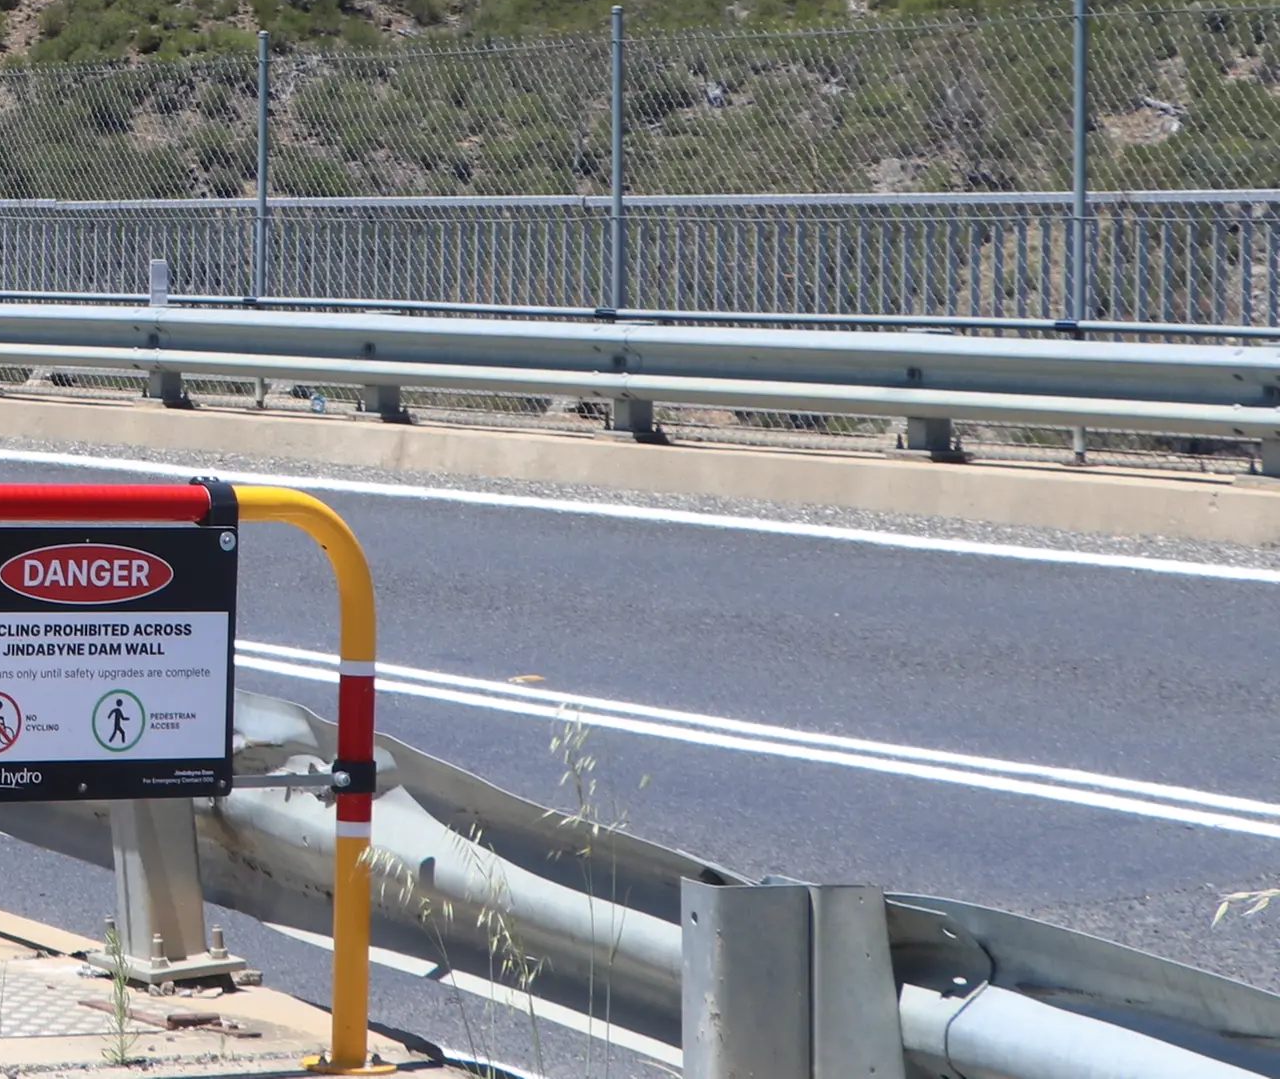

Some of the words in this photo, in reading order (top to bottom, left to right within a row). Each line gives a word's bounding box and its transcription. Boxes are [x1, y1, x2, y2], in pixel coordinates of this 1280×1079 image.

[23, 559, 149, 587] DANGER
[43, 624, 130, 637] PROHIBITED
[133, 624, 192, 636] ACROSS
[2, 643, 85, 656] JINDABYNE
[88, 643, 122, 656] DAM
[125, 643, 165, 656] WALL
[16, 668, 36, 682] only
[40, 668, 62, 679] until
[64, 668, 95, 681] safety
[98, 668, 144, 681] upgrades
[147, 670, 162, 678] are
[165, 667, 210, 681] complete
[25, 724, 59, 732] CYCLING
[150, 722, 180, 730] ACCESS
